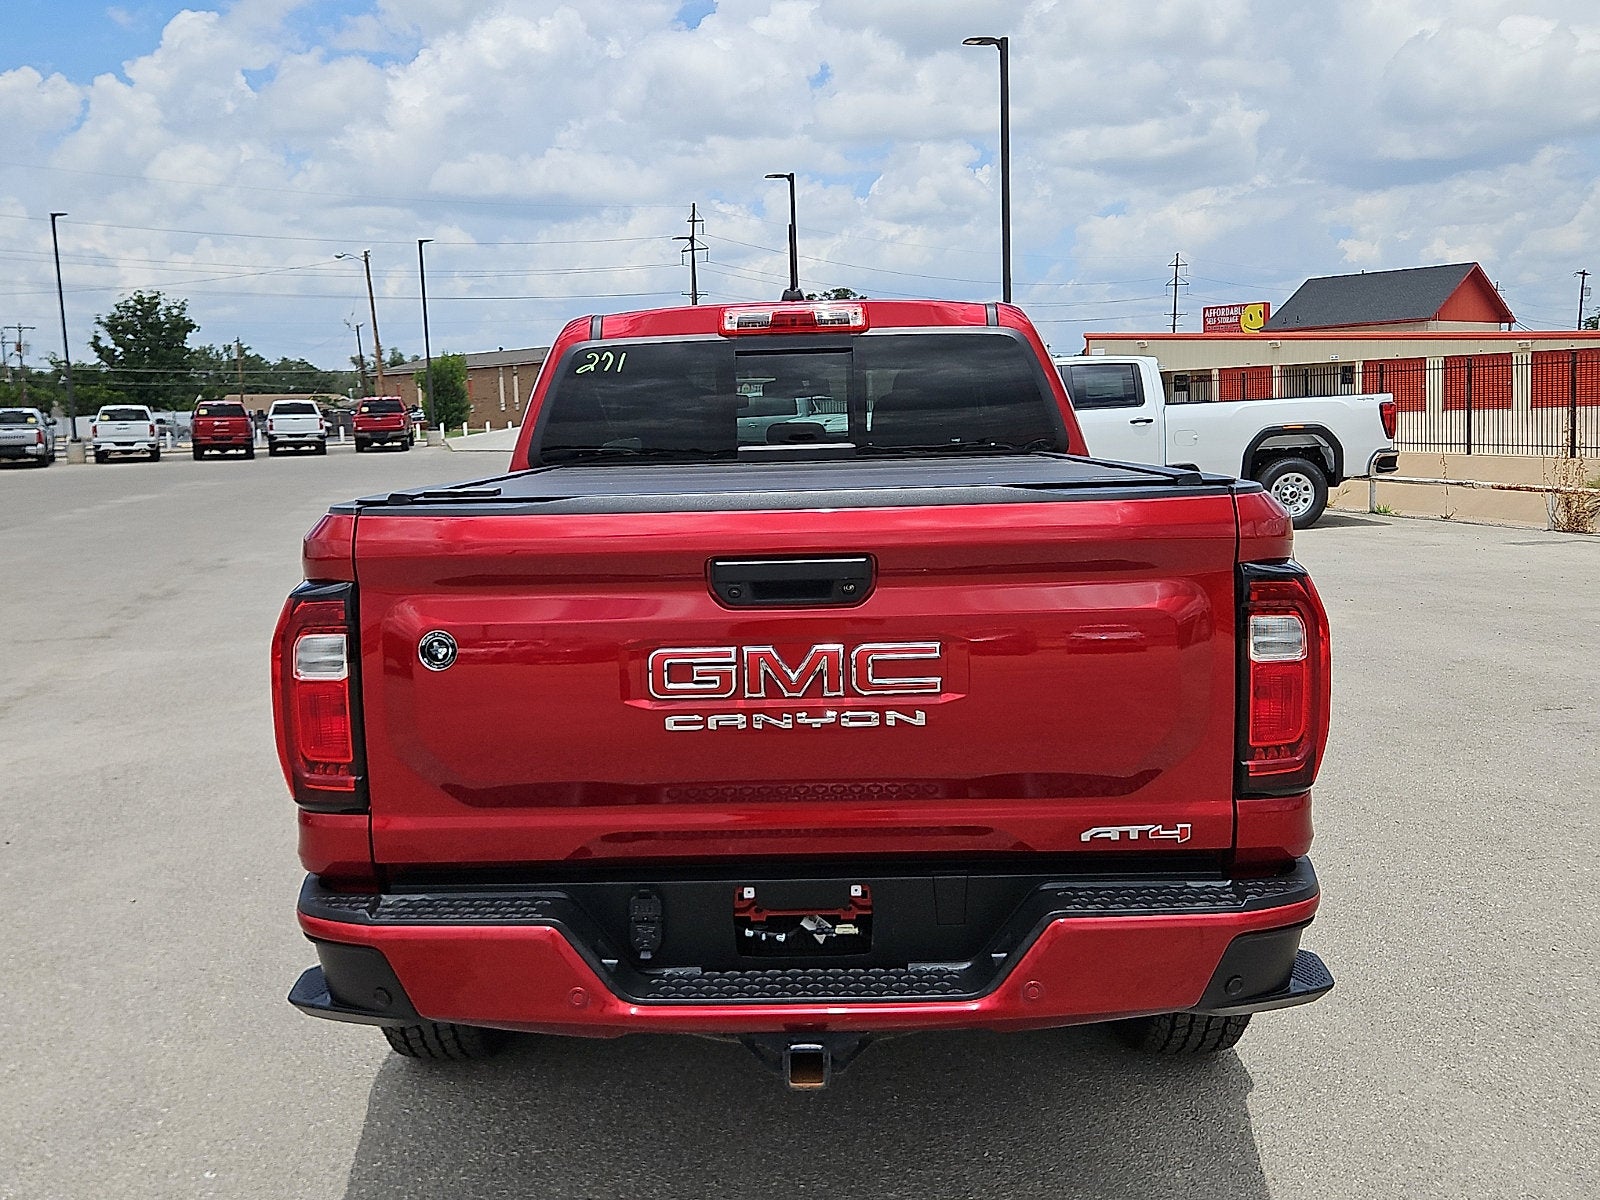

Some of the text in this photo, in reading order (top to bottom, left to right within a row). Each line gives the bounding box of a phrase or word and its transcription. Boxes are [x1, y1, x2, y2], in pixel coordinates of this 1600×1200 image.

[1205, 306, 1245, 317] AFFORDABLE
[1217, 316, 1239, 324] STORAGE
[576, 351, 627, 374] 271
[649, 642, 941, 698] GMC
[665, 710, 926, 731] CANYON
[1081, 824, 1192, 843] AT4
